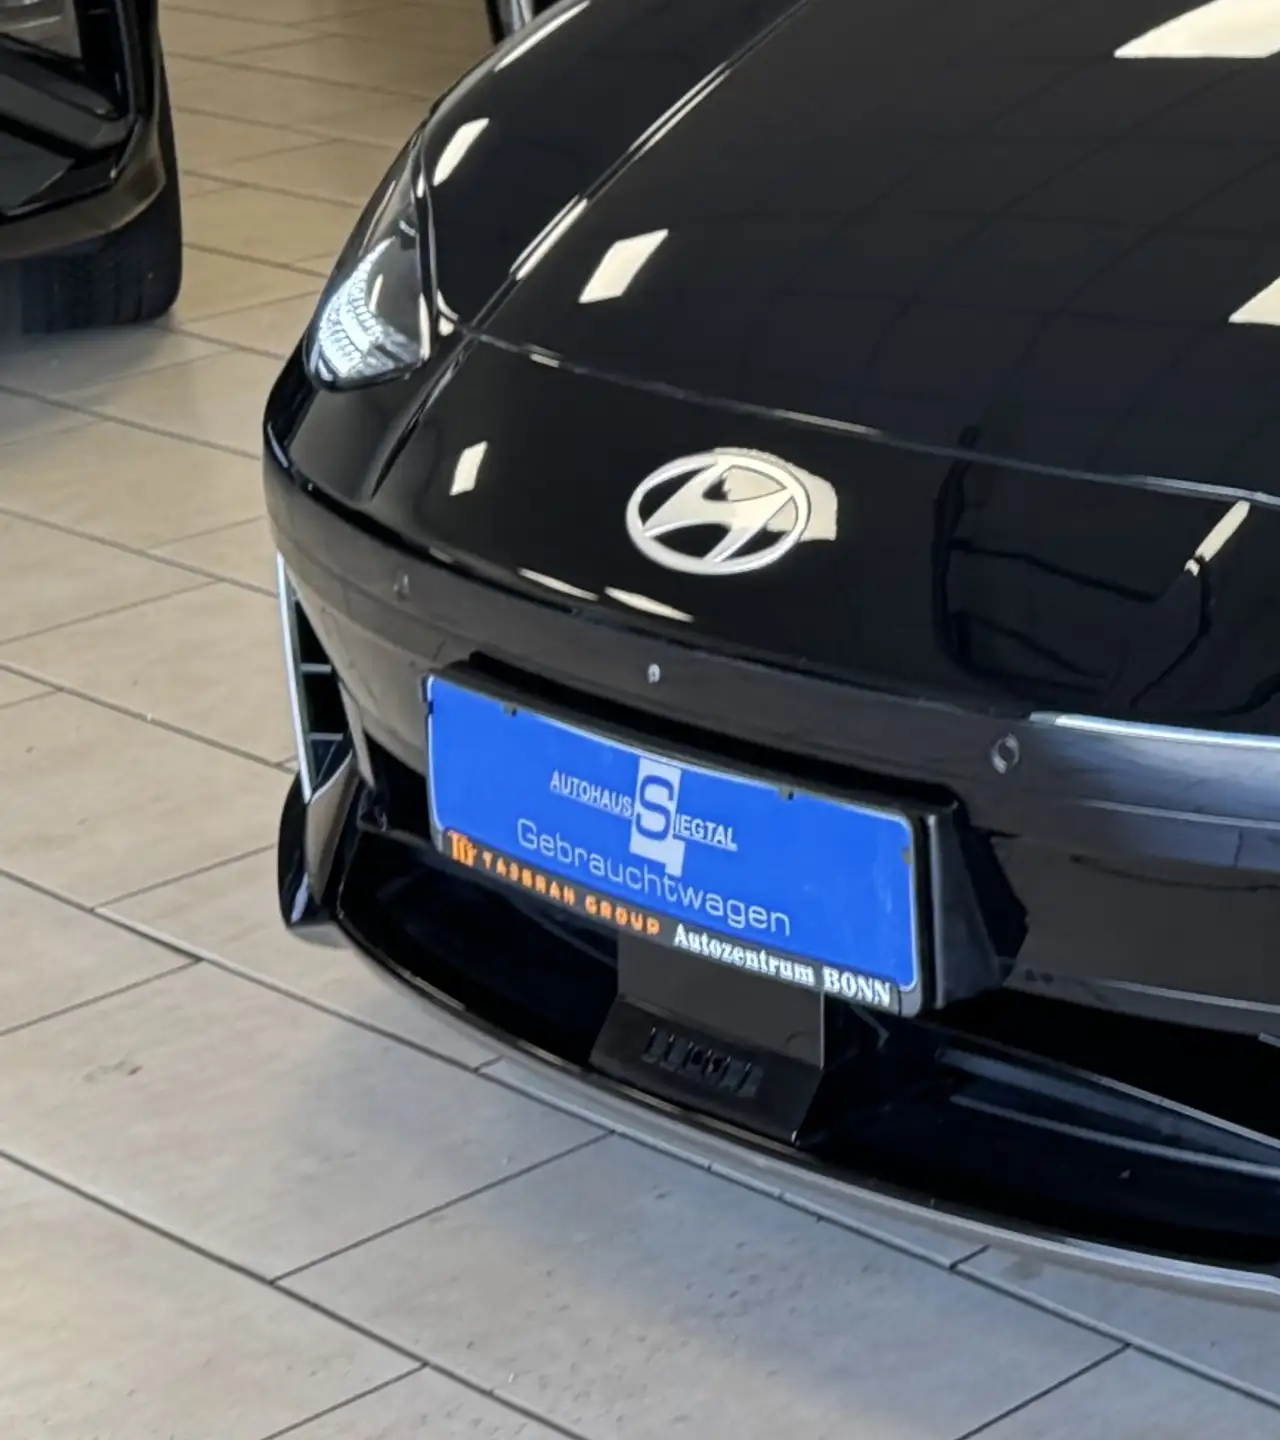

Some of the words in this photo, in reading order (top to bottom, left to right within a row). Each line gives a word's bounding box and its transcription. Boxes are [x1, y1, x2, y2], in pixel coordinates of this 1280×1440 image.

[550, 769, 633, 819] AUTOHAUS
[635, 773, 738, 852] SIEGTAL
[516, 818, 791, 937] Gebrauchtwagen
[584, 893, 660, 936] GROUP
[672, 923, 816, 987] Autozentrum
[822, 965, 892, 1007] BONN
